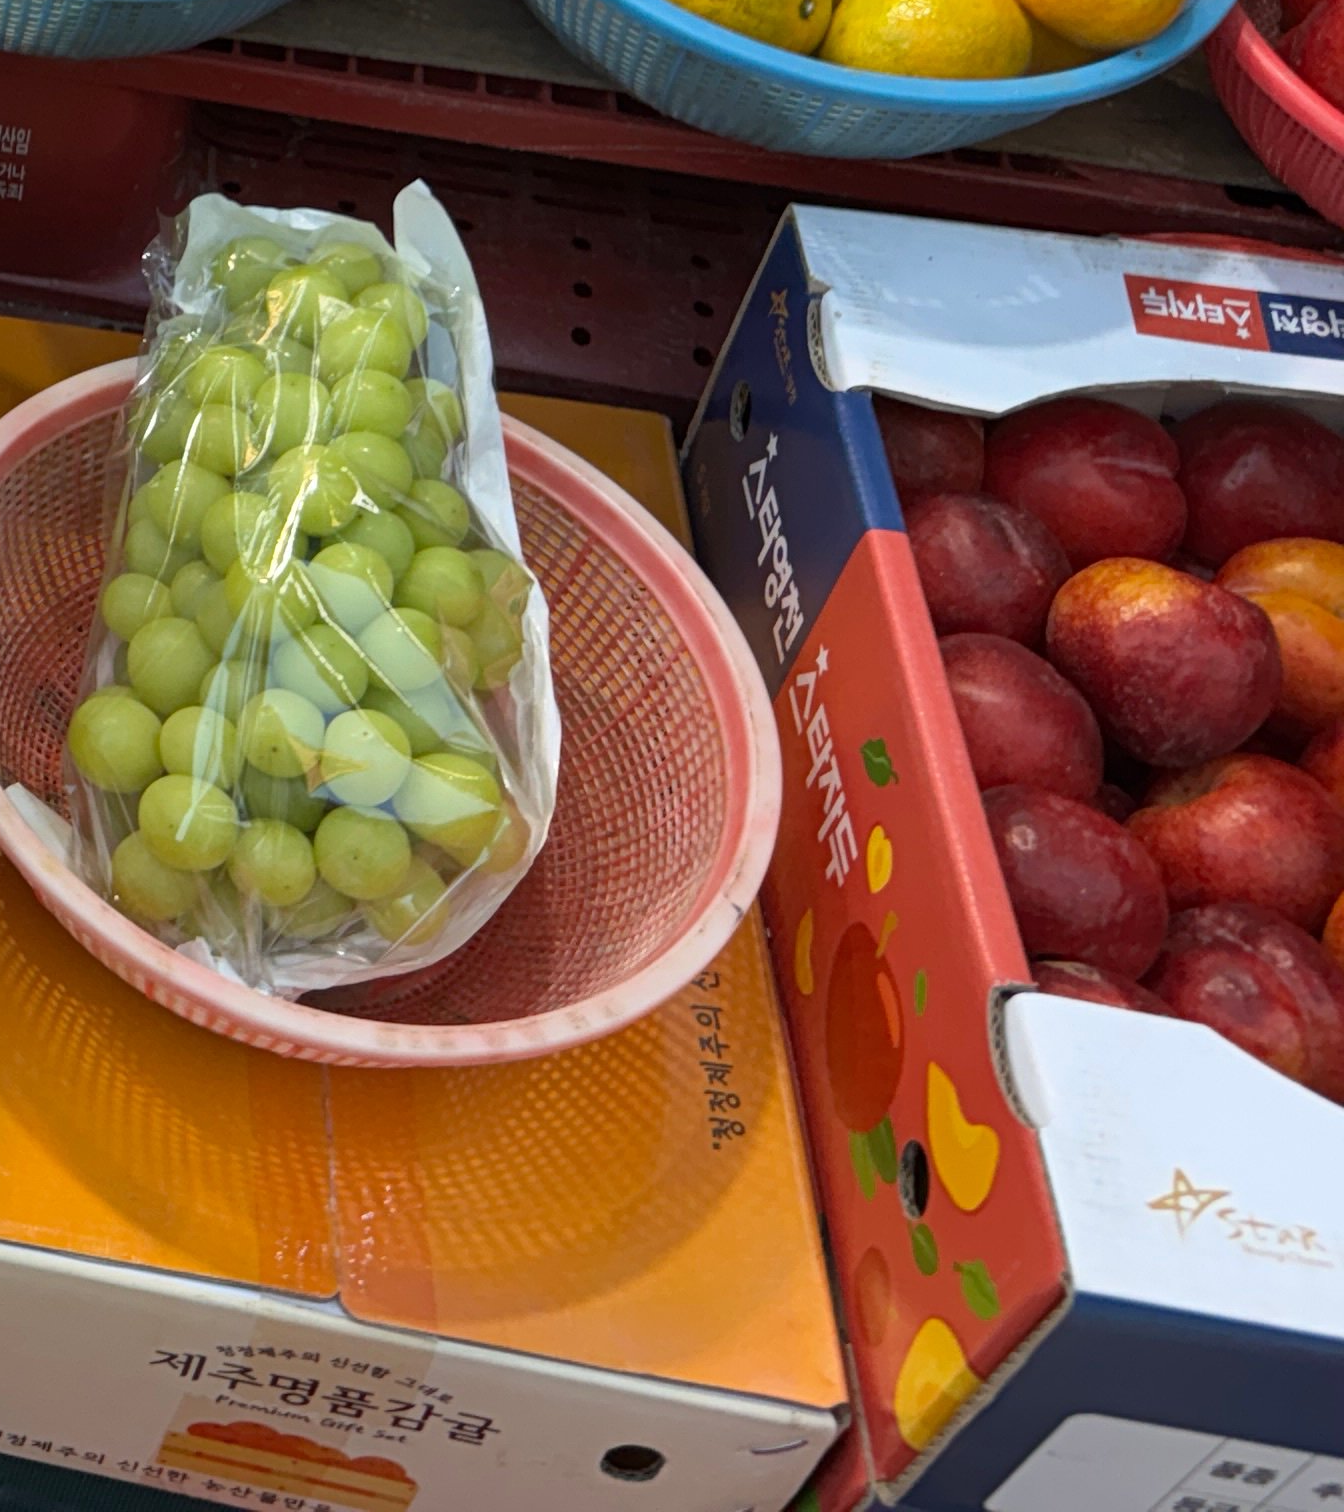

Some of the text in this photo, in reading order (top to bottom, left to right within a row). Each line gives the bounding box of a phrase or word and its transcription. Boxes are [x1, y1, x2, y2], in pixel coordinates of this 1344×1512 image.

[1139, 285, 1252, 327] 스타자두
[742, 456, 859, 888] 스타영천 스타자두
[148, 1348, 502, 1446] 제주명품감귤
[215, 1393, 311, 1424] Premium
